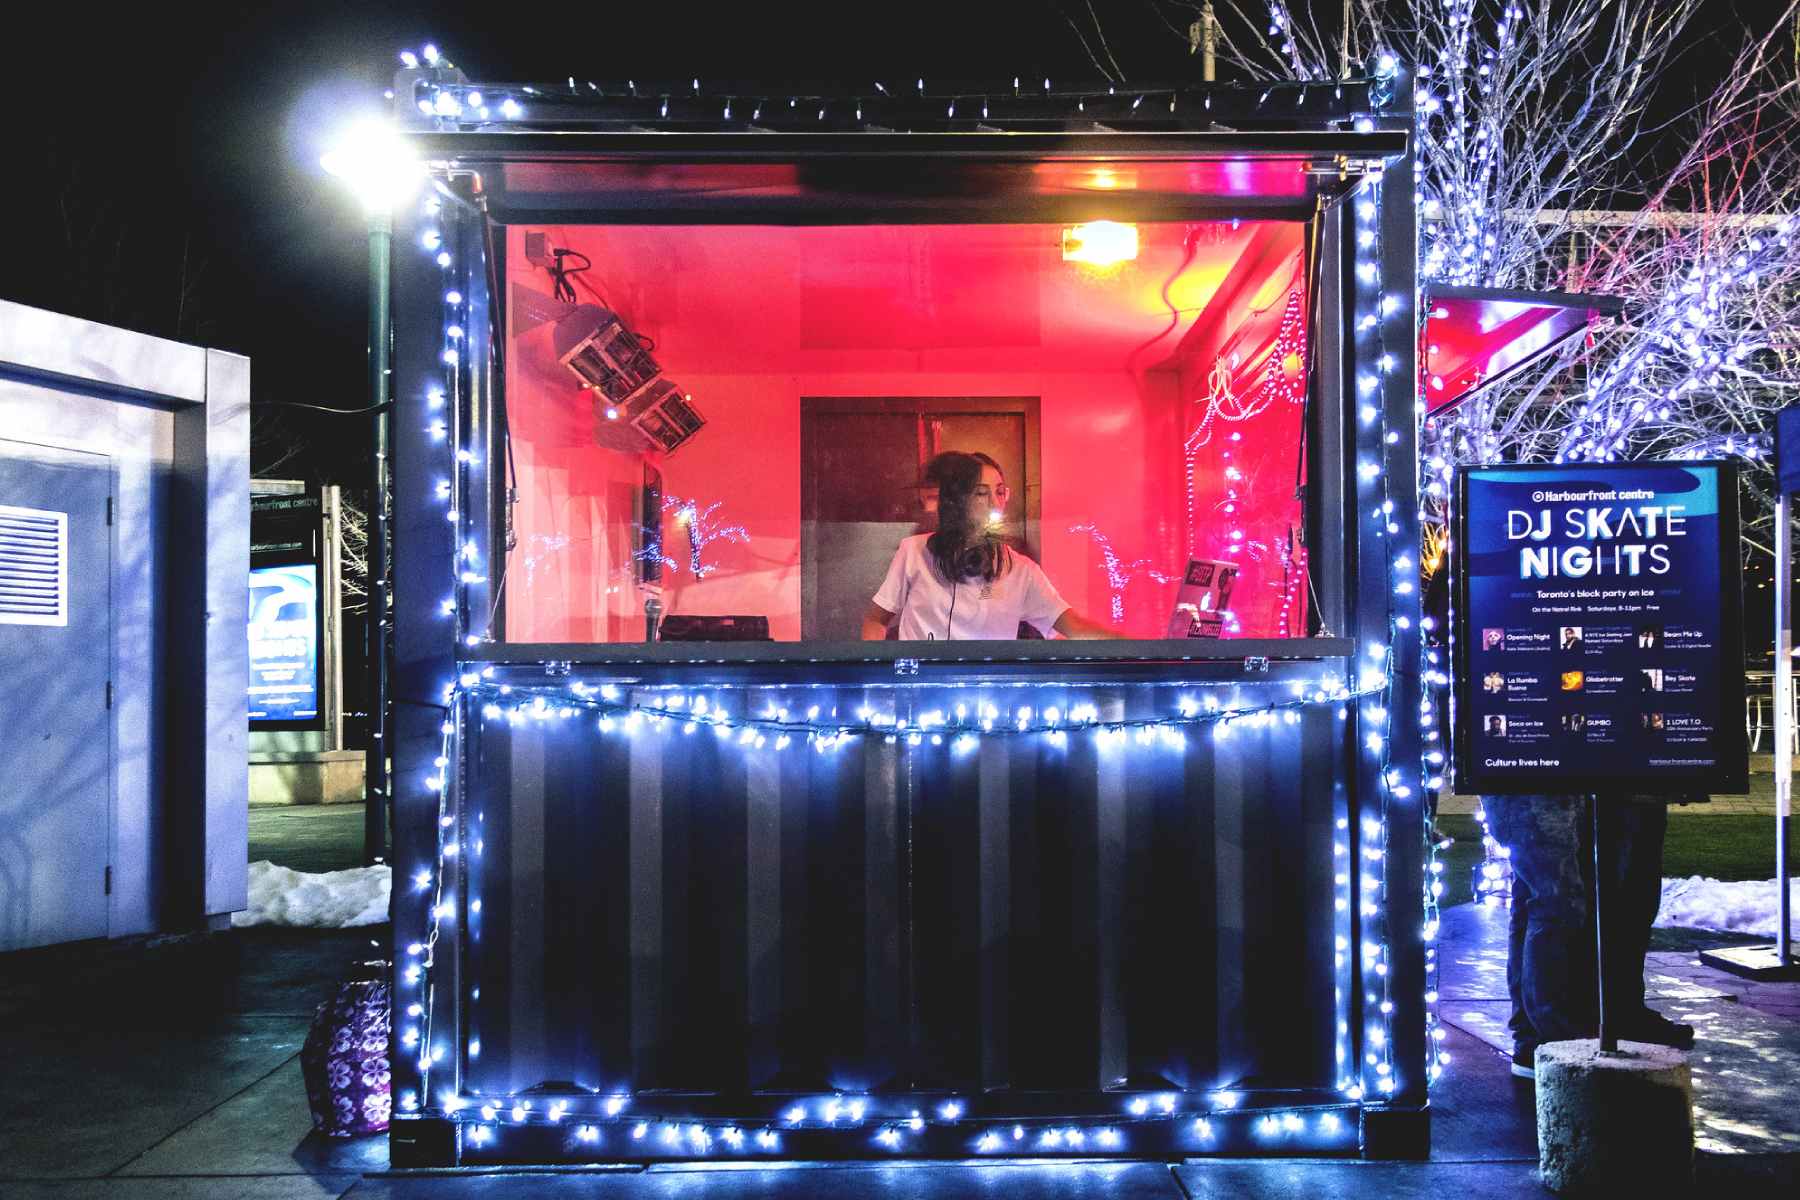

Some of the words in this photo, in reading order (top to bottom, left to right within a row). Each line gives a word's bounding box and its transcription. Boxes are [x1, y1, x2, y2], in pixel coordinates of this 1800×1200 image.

[1544, 490, 1617, 502] Harbourfront
[1618, 488, 1655, 500] centre
[1507, 509, 1552, 541] DJ
[1565, 505, 1687, 540] SKATE
[1520, 544, 1671, 580] NIGHTS
[1537, 590, 1575, 599] Toronto's
[1576, 590, 1601, 598] block
[1602, 590, 1626, 599] party
[1641, 588, 1655, 597] ice
[1506, 633, 1533, 642] Opening
[1533, 633, 1551, 642] Night
[1693, 630, 1703, 638] Up
[1677, 674, 1696, 682] Skate
[1672, 718, 1689, 726] LOVE
[1485, 758, 1518, 767] Culture
[1518, 757, 1539, 767] lives
[1539, 757, 1560, 767] here
